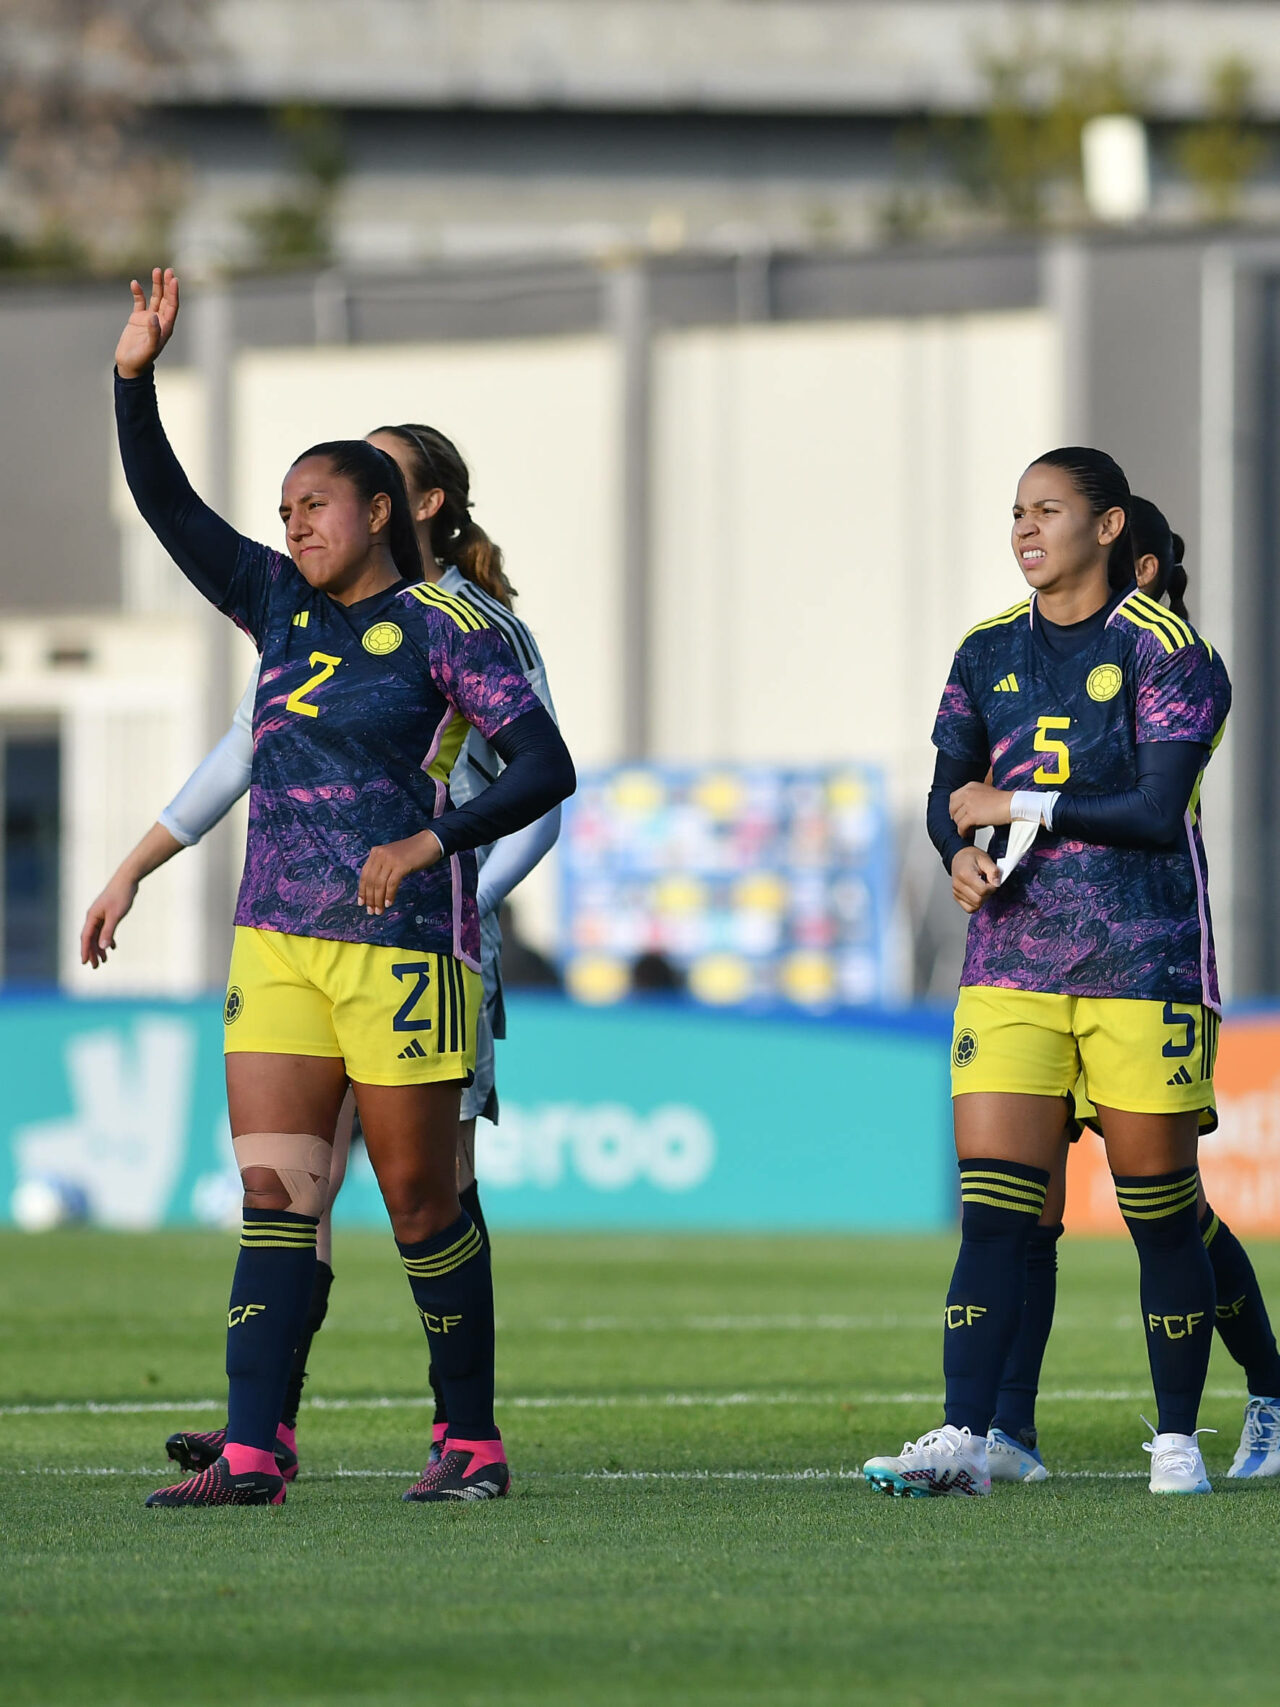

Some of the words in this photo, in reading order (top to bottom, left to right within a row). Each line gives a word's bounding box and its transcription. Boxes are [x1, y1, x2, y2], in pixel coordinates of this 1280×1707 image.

[286, 651, 342, 718] 2
[1033, 715, 1071, 784] 5
[391, 961, 432, 1032] 2
[1162, 1001, 1196, 1057] 5
[944, 1304, 988, 1330] CF
[1148, 1311, 1205, 1340] FCF
